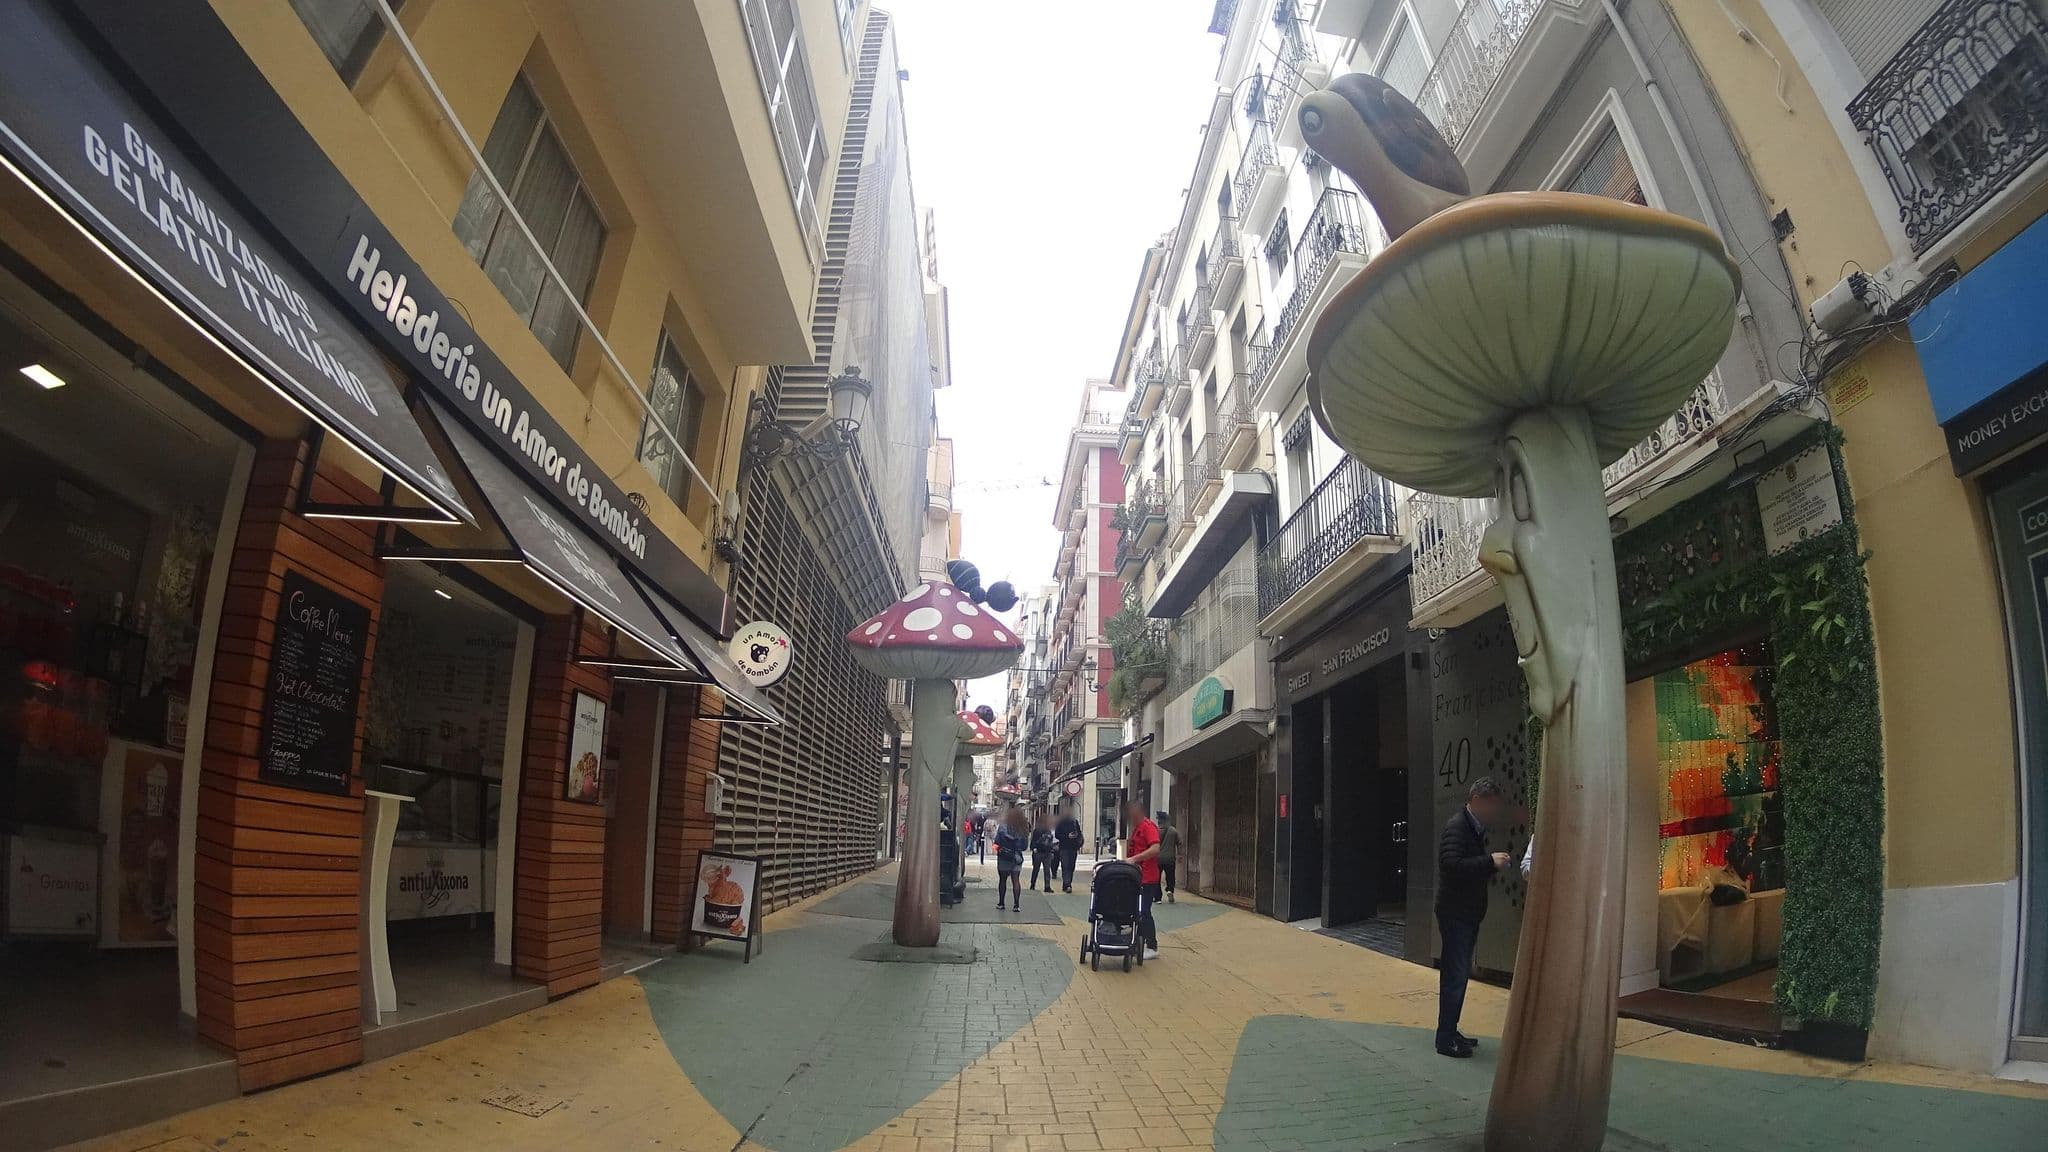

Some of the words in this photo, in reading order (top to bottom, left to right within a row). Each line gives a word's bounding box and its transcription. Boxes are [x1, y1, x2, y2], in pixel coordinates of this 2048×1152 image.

[123, 122, 318, 333] GRANIZADOS
[84, 124, 227, 289] GELATO
[231, 266, 379, 417] ITALIANO
[346, 234, 481, 401] Heladería
[481, 381, 513, 435] un
[511, 410, 567, 484] Amor
[566, 462, 589, 507] de
[588, 482, 647, 560] Bombón
[1957, 414, 2007, 453] MONEY
[289, 590, 325, 633] Coffee
[742, 633, 754, 645] un
[756, 630, 779, 645] Amor
[1287, 671, 1312, 694] SWEET
[1322, 655, 1339, 675] SAN
[1339, 627, 1390, 668] FRANCISCO
[737, 659, 746, 670] de
[745, 661, 779, 677] Bombón
[1433, 651, 1458, 679] San
[1439, 737, 1471, 787] 40
